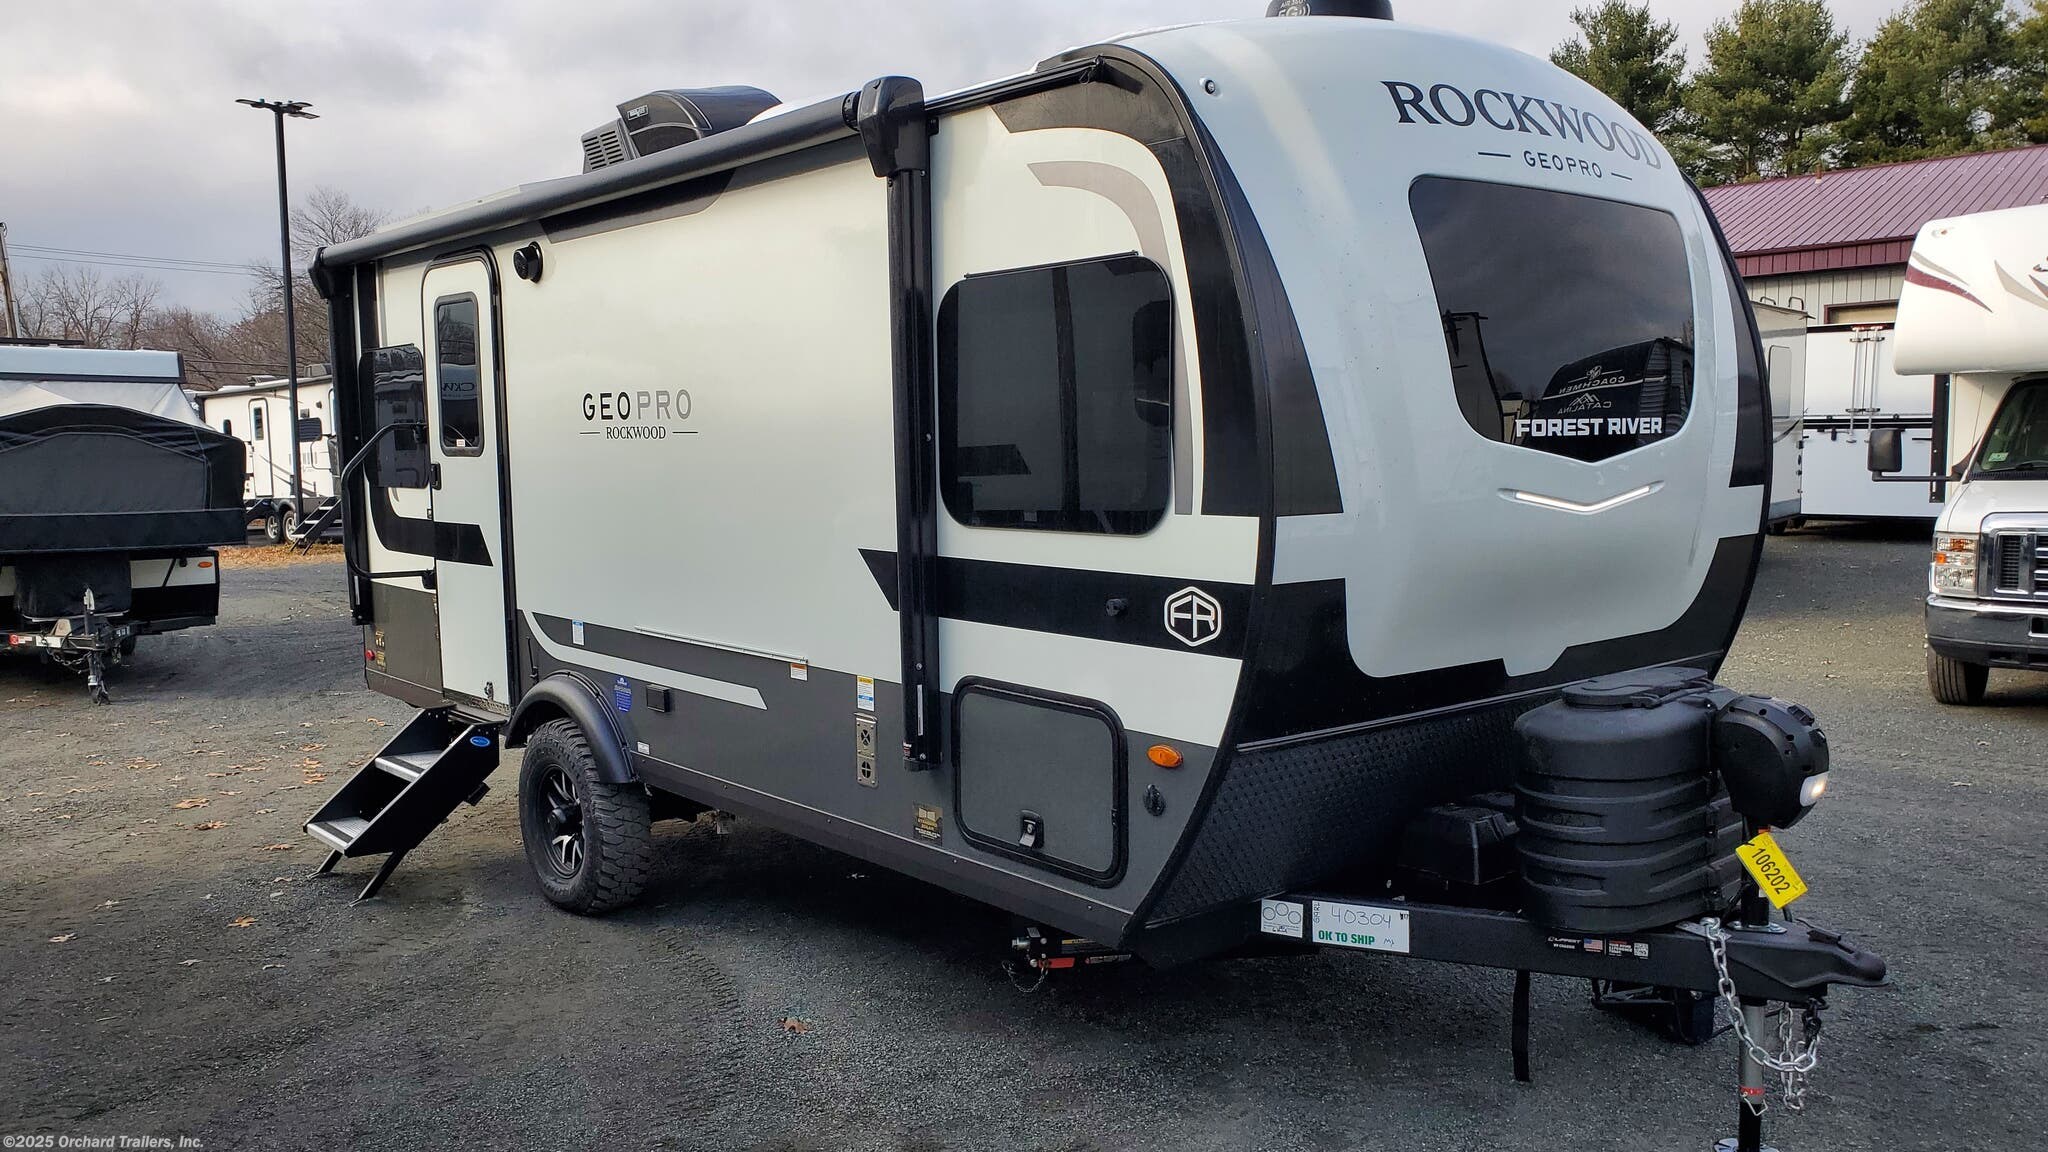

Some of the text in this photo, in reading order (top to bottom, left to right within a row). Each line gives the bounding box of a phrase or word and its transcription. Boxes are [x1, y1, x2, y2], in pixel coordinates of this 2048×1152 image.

[1380, 80, 1662, 170] ROCKWOOD
[1523, 150, 1603, 179] GEOPRO
[583, 389, 692, 420] GEOPRO
[606, 426, 667, 439] ROCKWOOD
[1515, 417, 1663, 437] FOREST RIVER
[1752, 848, 1790, 894] 106202
[1331, 904, 1391, 929] 40304
[1318, 930, 1332, 941] OK
[1335, 931, 1348, 942] TO
[1351, 933, 1375, 945] SHIP
